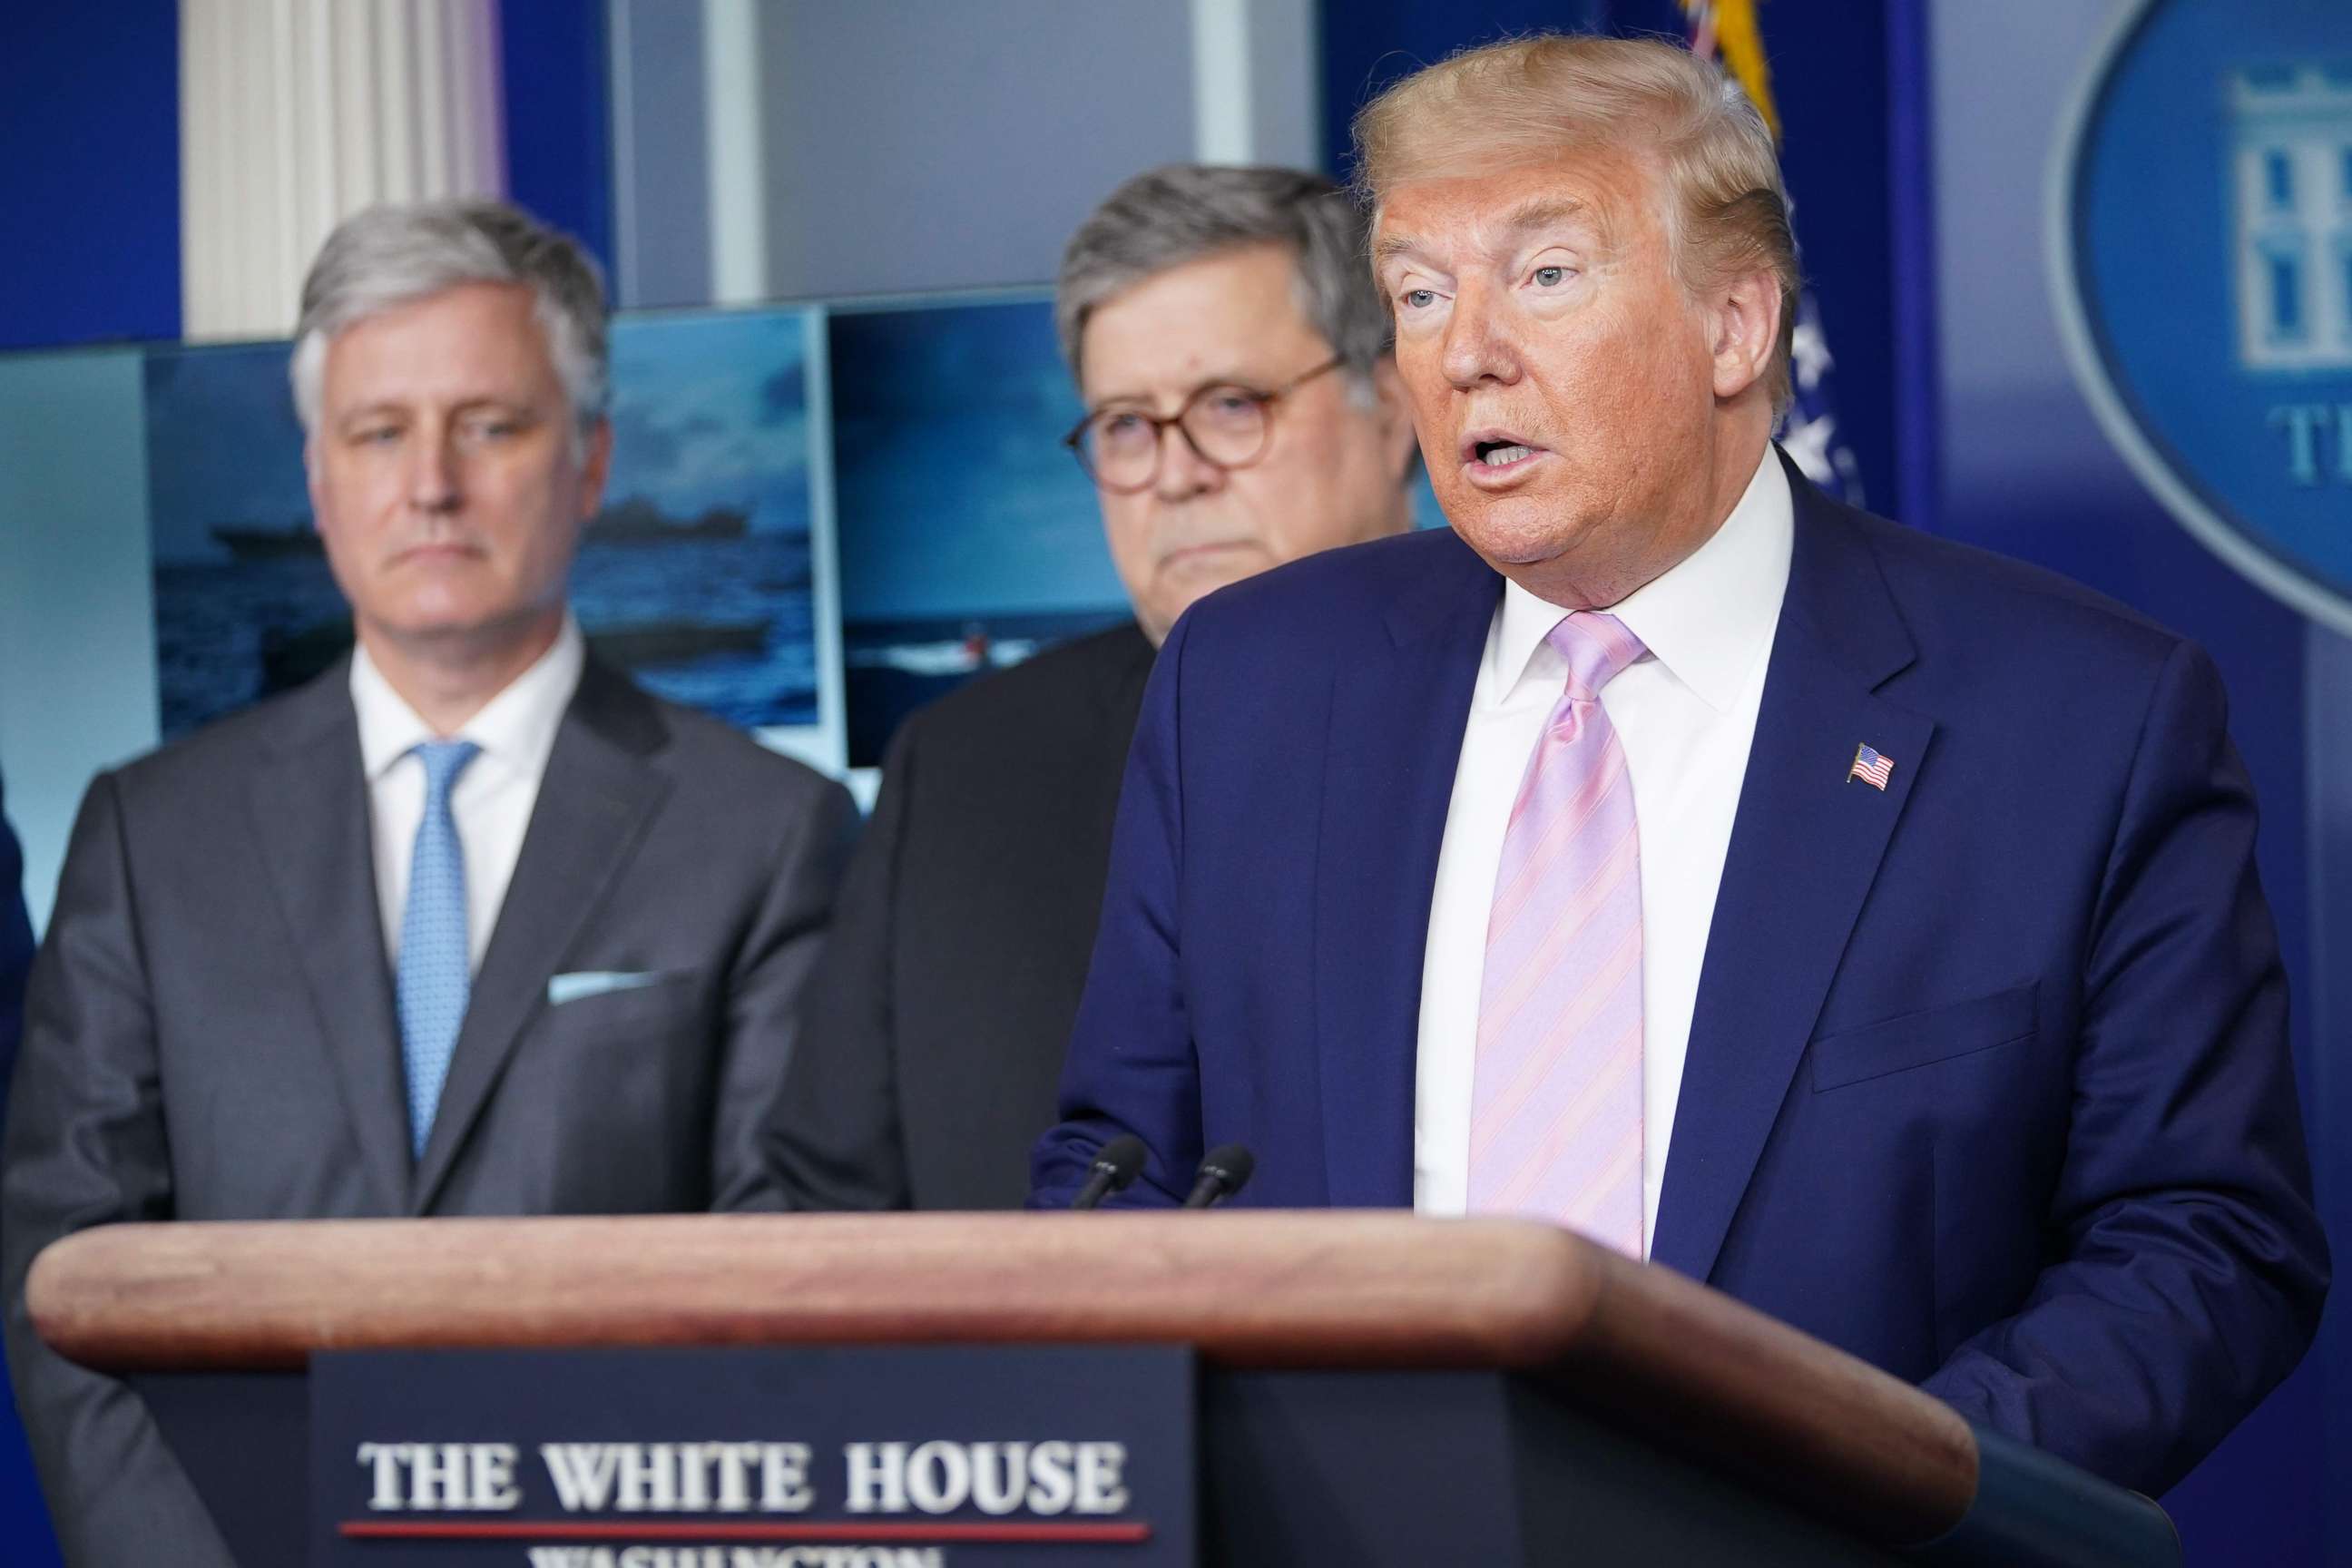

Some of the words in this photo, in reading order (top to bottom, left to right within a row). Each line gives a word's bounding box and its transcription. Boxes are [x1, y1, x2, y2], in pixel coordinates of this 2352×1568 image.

[356, 1442, 522, 1511] THE
[540, 1442, 815, 1511] WHITE
[845, 1441, 1128, 1514] HOUSE
